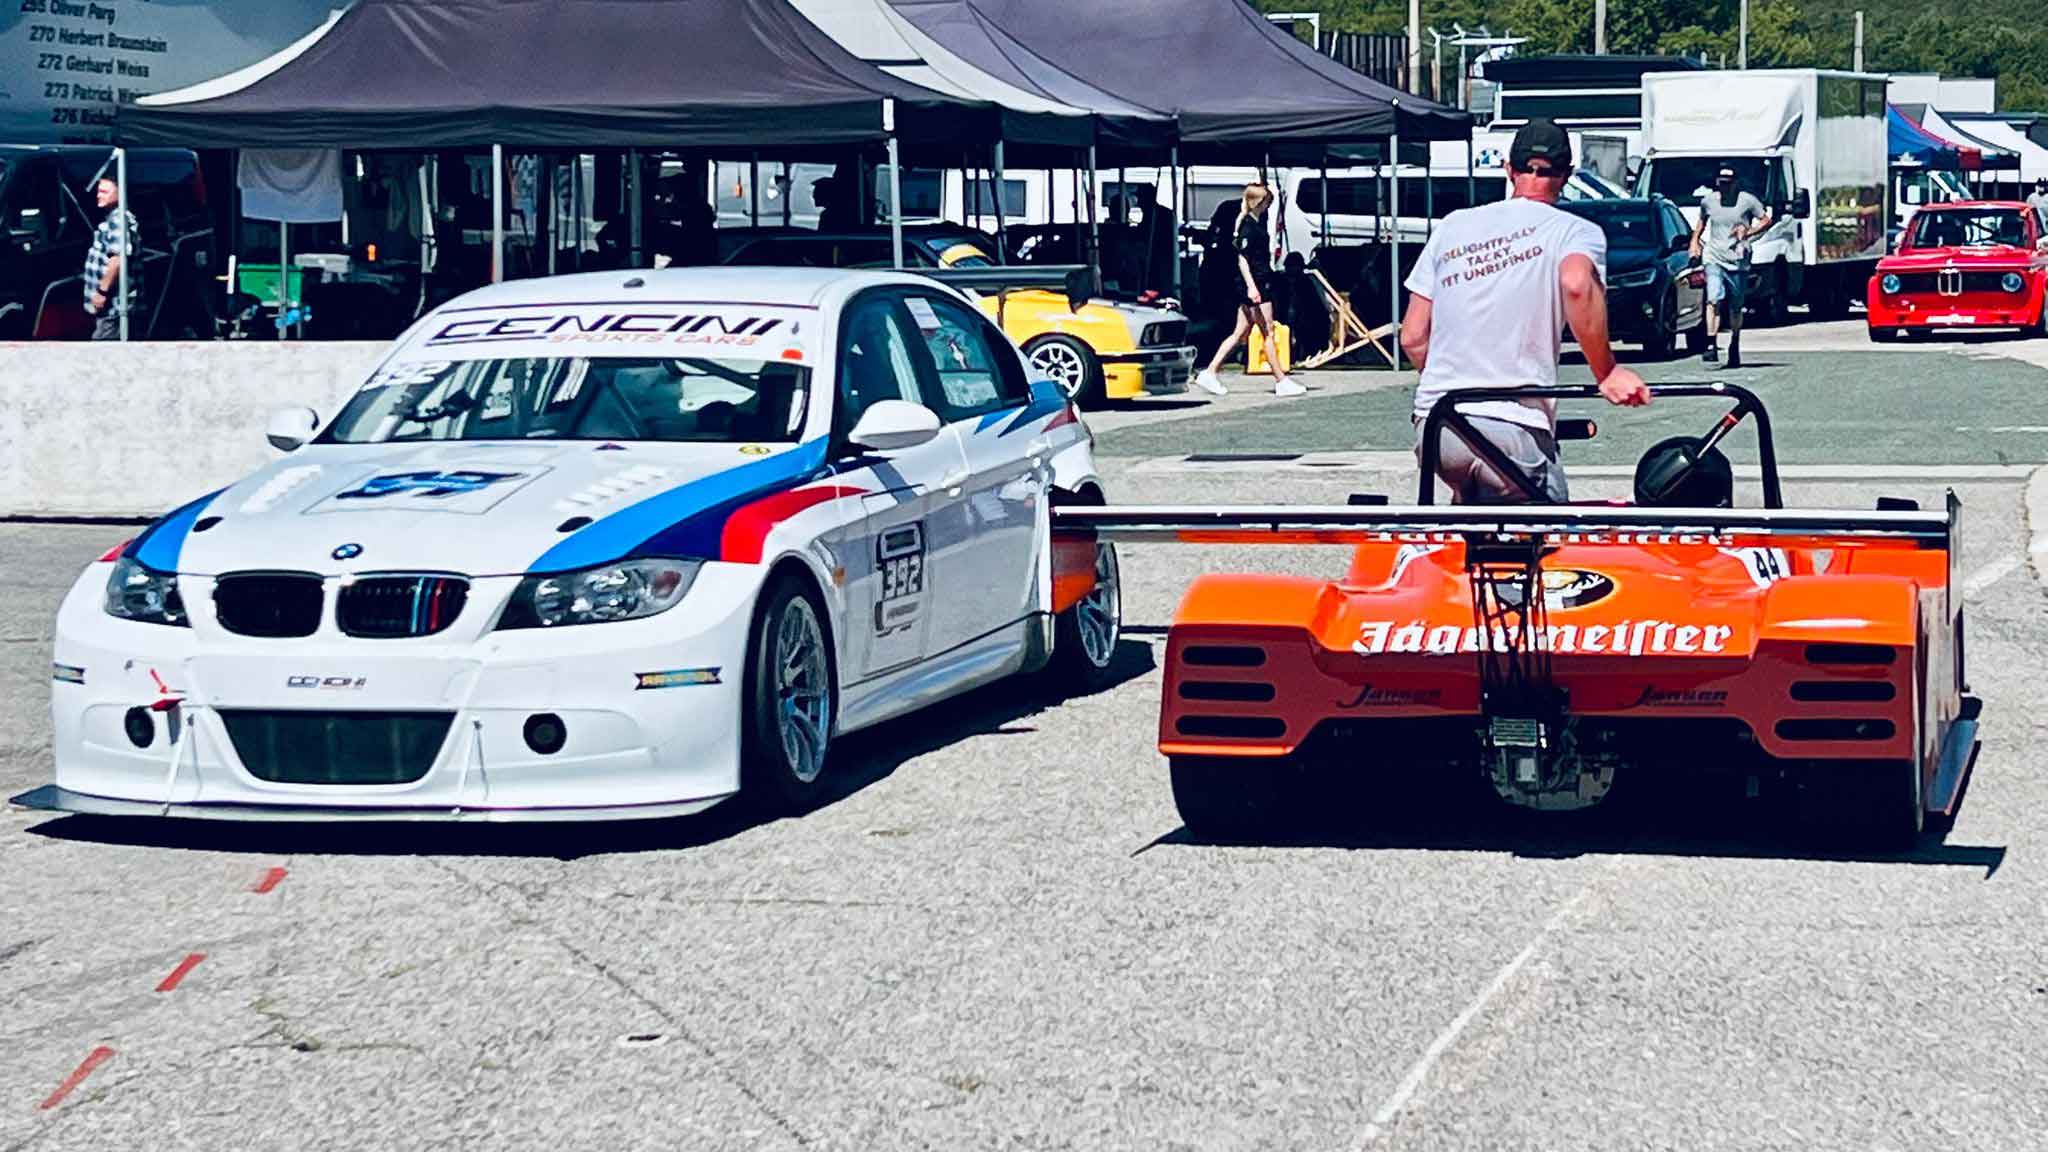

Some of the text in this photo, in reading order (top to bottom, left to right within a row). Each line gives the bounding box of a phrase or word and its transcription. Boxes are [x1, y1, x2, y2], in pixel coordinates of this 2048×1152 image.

[29, 25, 55, 42] 270
[59, 28, 104, 46] Herbert
[38, 53, 63, 71] 272
[66, 55, 113, 74] Gerhard
[44, 82, 69, 98] 273
[72, 84, 113, 102] Patrick
[1464, 245, 1543, 281] UNREFINED
[429, 314, 783, 341] CENCINI
[673, 335, 760, 346] CARS
[1753, 548, 1780, 581] 44
